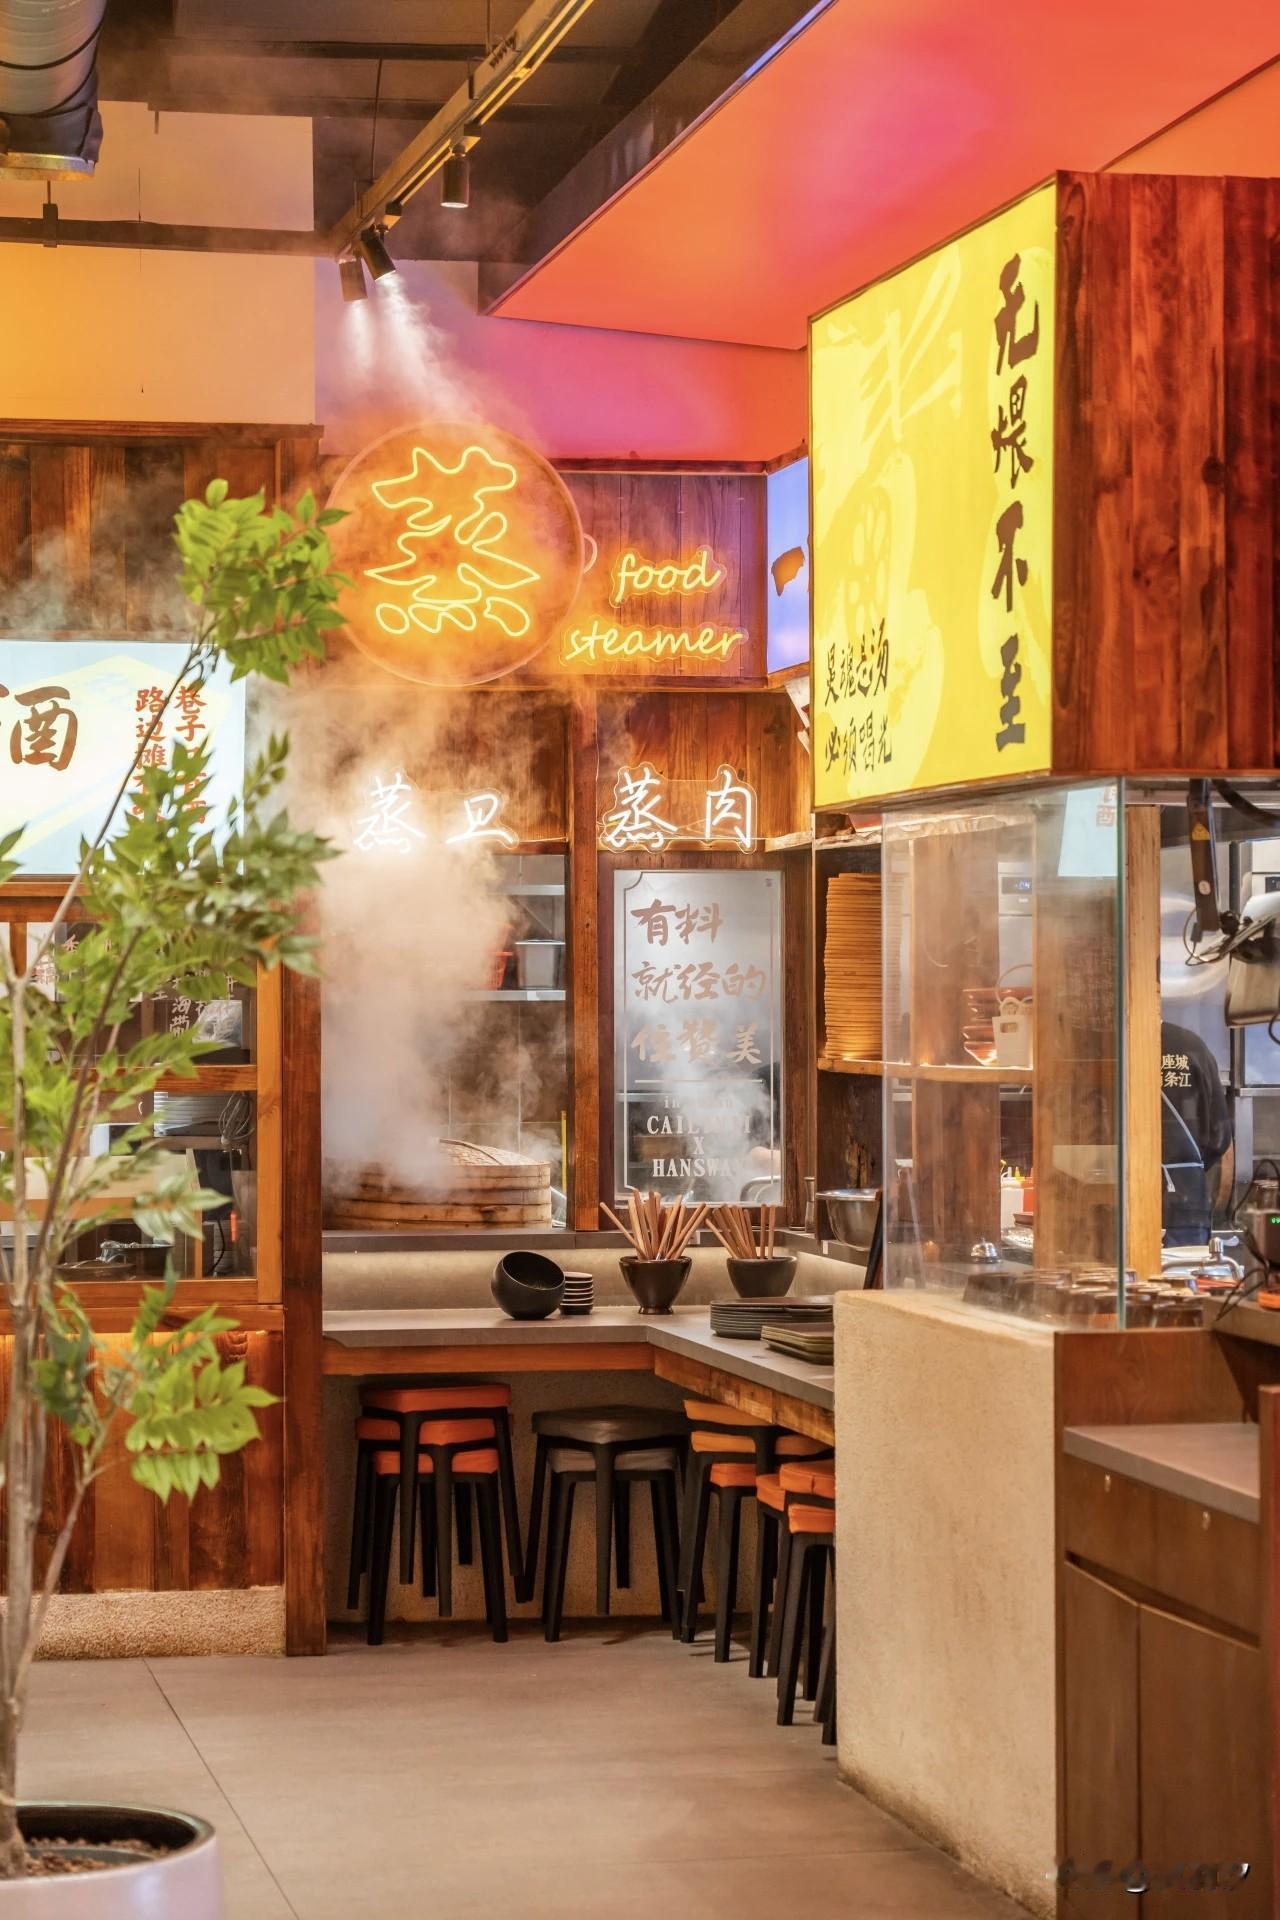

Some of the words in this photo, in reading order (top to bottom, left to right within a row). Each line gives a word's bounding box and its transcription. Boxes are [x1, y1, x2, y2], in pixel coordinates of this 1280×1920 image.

[364, 446, 540, 637] 蒸
[614, 549, 722, 604] food
[565, 620, 744, 661] steamer
[133, 686, 168, 822] 路边摊
[605, 767, 753, 848] 蒸肉
[630, 898, 724, 946] 有料
[1160, 1070, 1192, 1087] 条江
[646, 1115, 751, 1134] CAILI
